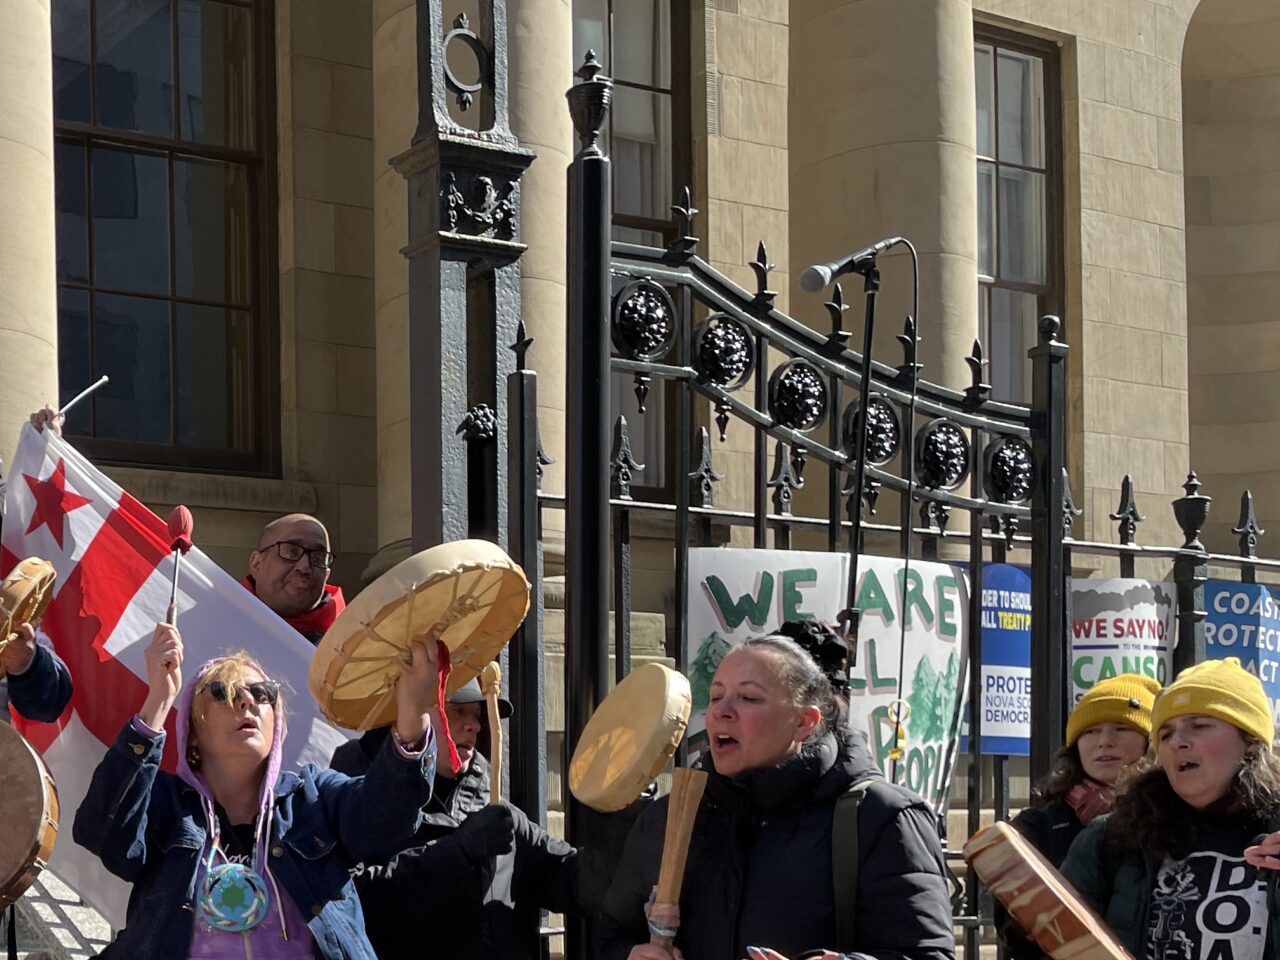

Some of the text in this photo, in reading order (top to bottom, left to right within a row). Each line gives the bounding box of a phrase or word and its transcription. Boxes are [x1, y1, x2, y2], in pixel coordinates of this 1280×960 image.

[702, 567, 958, 643] WE ARE
[1000, 591, 1010, 608] TO
[981, 610, 997, 628] ALL
[998, 611, 1025, 631] TREATY
[1072, 613, 1169, 641] WE SAY NO!
[1072, 655, 1167, 690] CANSO
[985, 695, 1015, 708] NOVA
